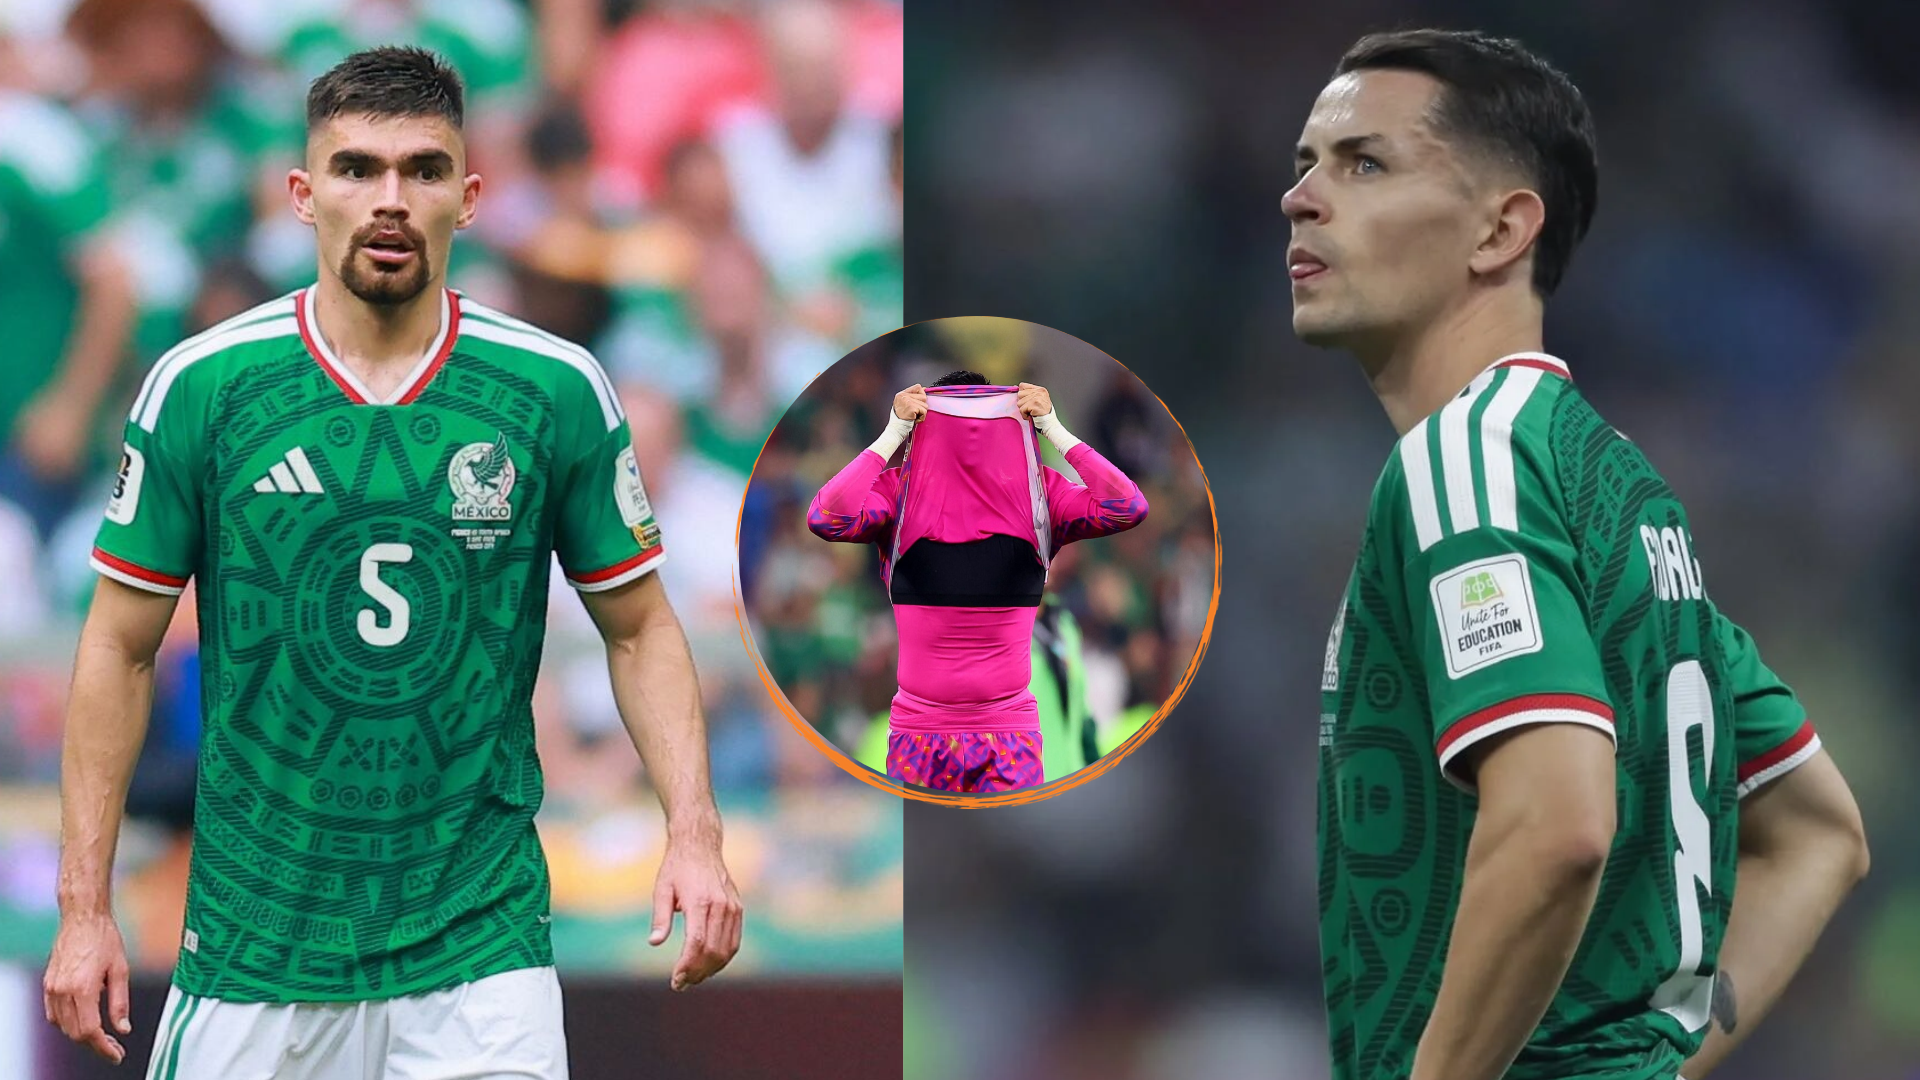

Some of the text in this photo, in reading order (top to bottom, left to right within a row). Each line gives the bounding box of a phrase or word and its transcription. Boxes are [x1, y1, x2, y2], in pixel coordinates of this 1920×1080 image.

[357, 542, 413, 646] 5
[1461, 602, 1510, 631] Unite For
[1458, 618, 1523, 652] EDUCATION
[1479, 641, 1502, 656] FIFA
